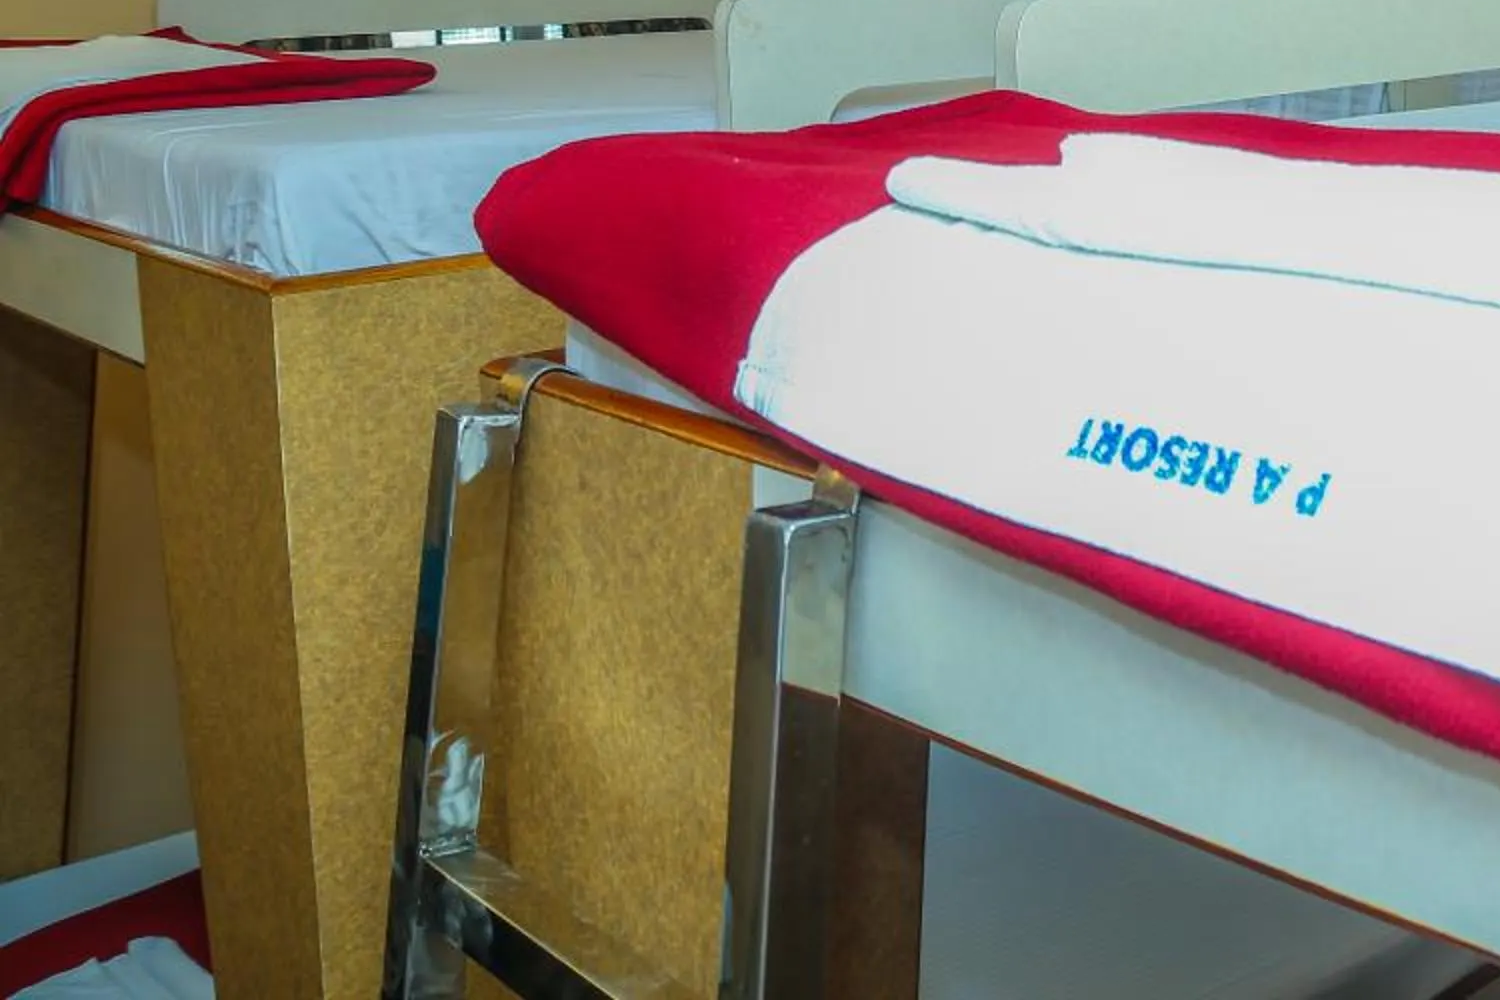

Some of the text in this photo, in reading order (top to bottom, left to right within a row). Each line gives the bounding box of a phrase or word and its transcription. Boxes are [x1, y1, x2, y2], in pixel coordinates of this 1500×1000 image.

[1065, 417, 1332, 517] P A RESORT
